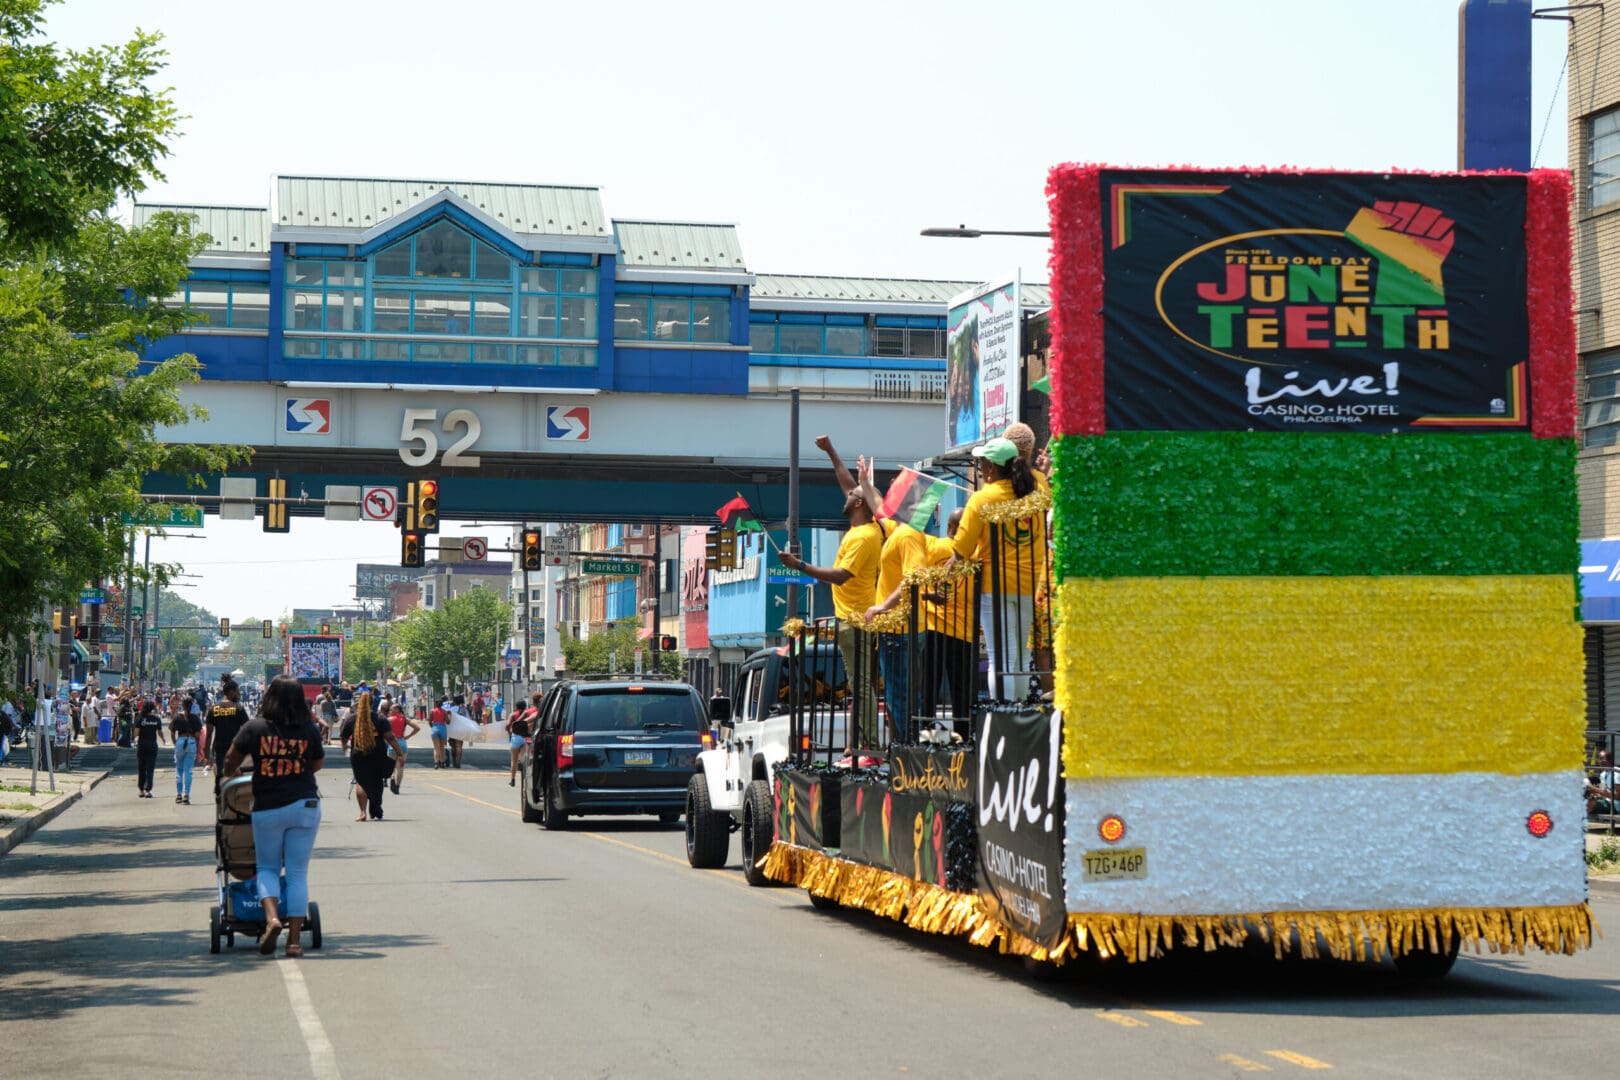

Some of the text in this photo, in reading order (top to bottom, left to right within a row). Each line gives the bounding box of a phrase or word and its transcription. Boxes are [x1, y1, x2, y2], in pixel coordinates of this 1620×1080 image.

[1225, 256, 1371, 265] FREEDOM DAY
[1197, 264, 1370, 303] JUNE
[1197, 305, 1449, 350] TEENTH
[1245, 362, 1399, 404] Live!
[1248, 405, 1399, 415] CASINO HOTEL
[398, 408, 481, 468] 52
[588, 563, 634, 572] Market St
[892, 751, 969, 792] Juneteenth
[1018, 855, 1051, 899] HOTEL
[1085, 855, 1143, 874] TZG 46P
